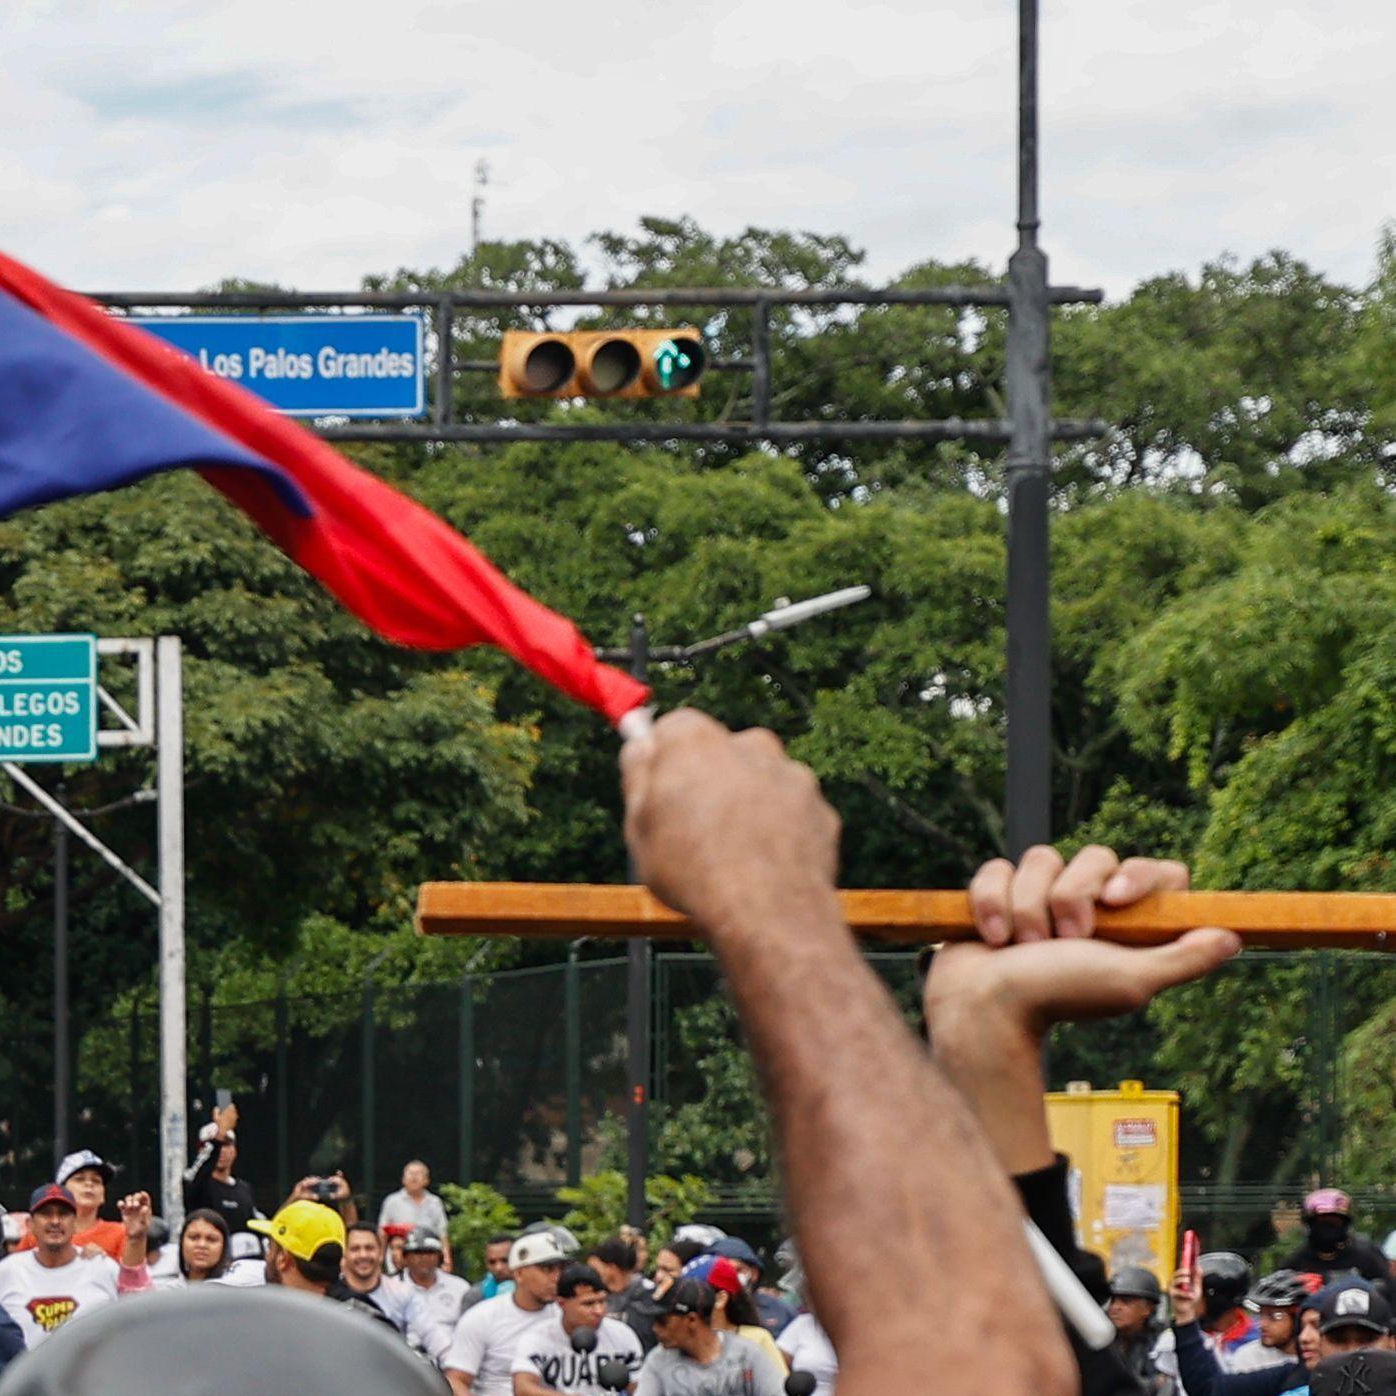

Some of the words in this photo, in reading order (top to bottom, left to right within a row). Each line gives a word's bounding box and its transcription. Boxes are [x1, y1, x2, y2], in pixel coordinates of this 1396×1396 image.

[199, 347, 243, 379] Los
[249, 346, 313, 379] Palos
[317, 345, 415, 379] Grandes
